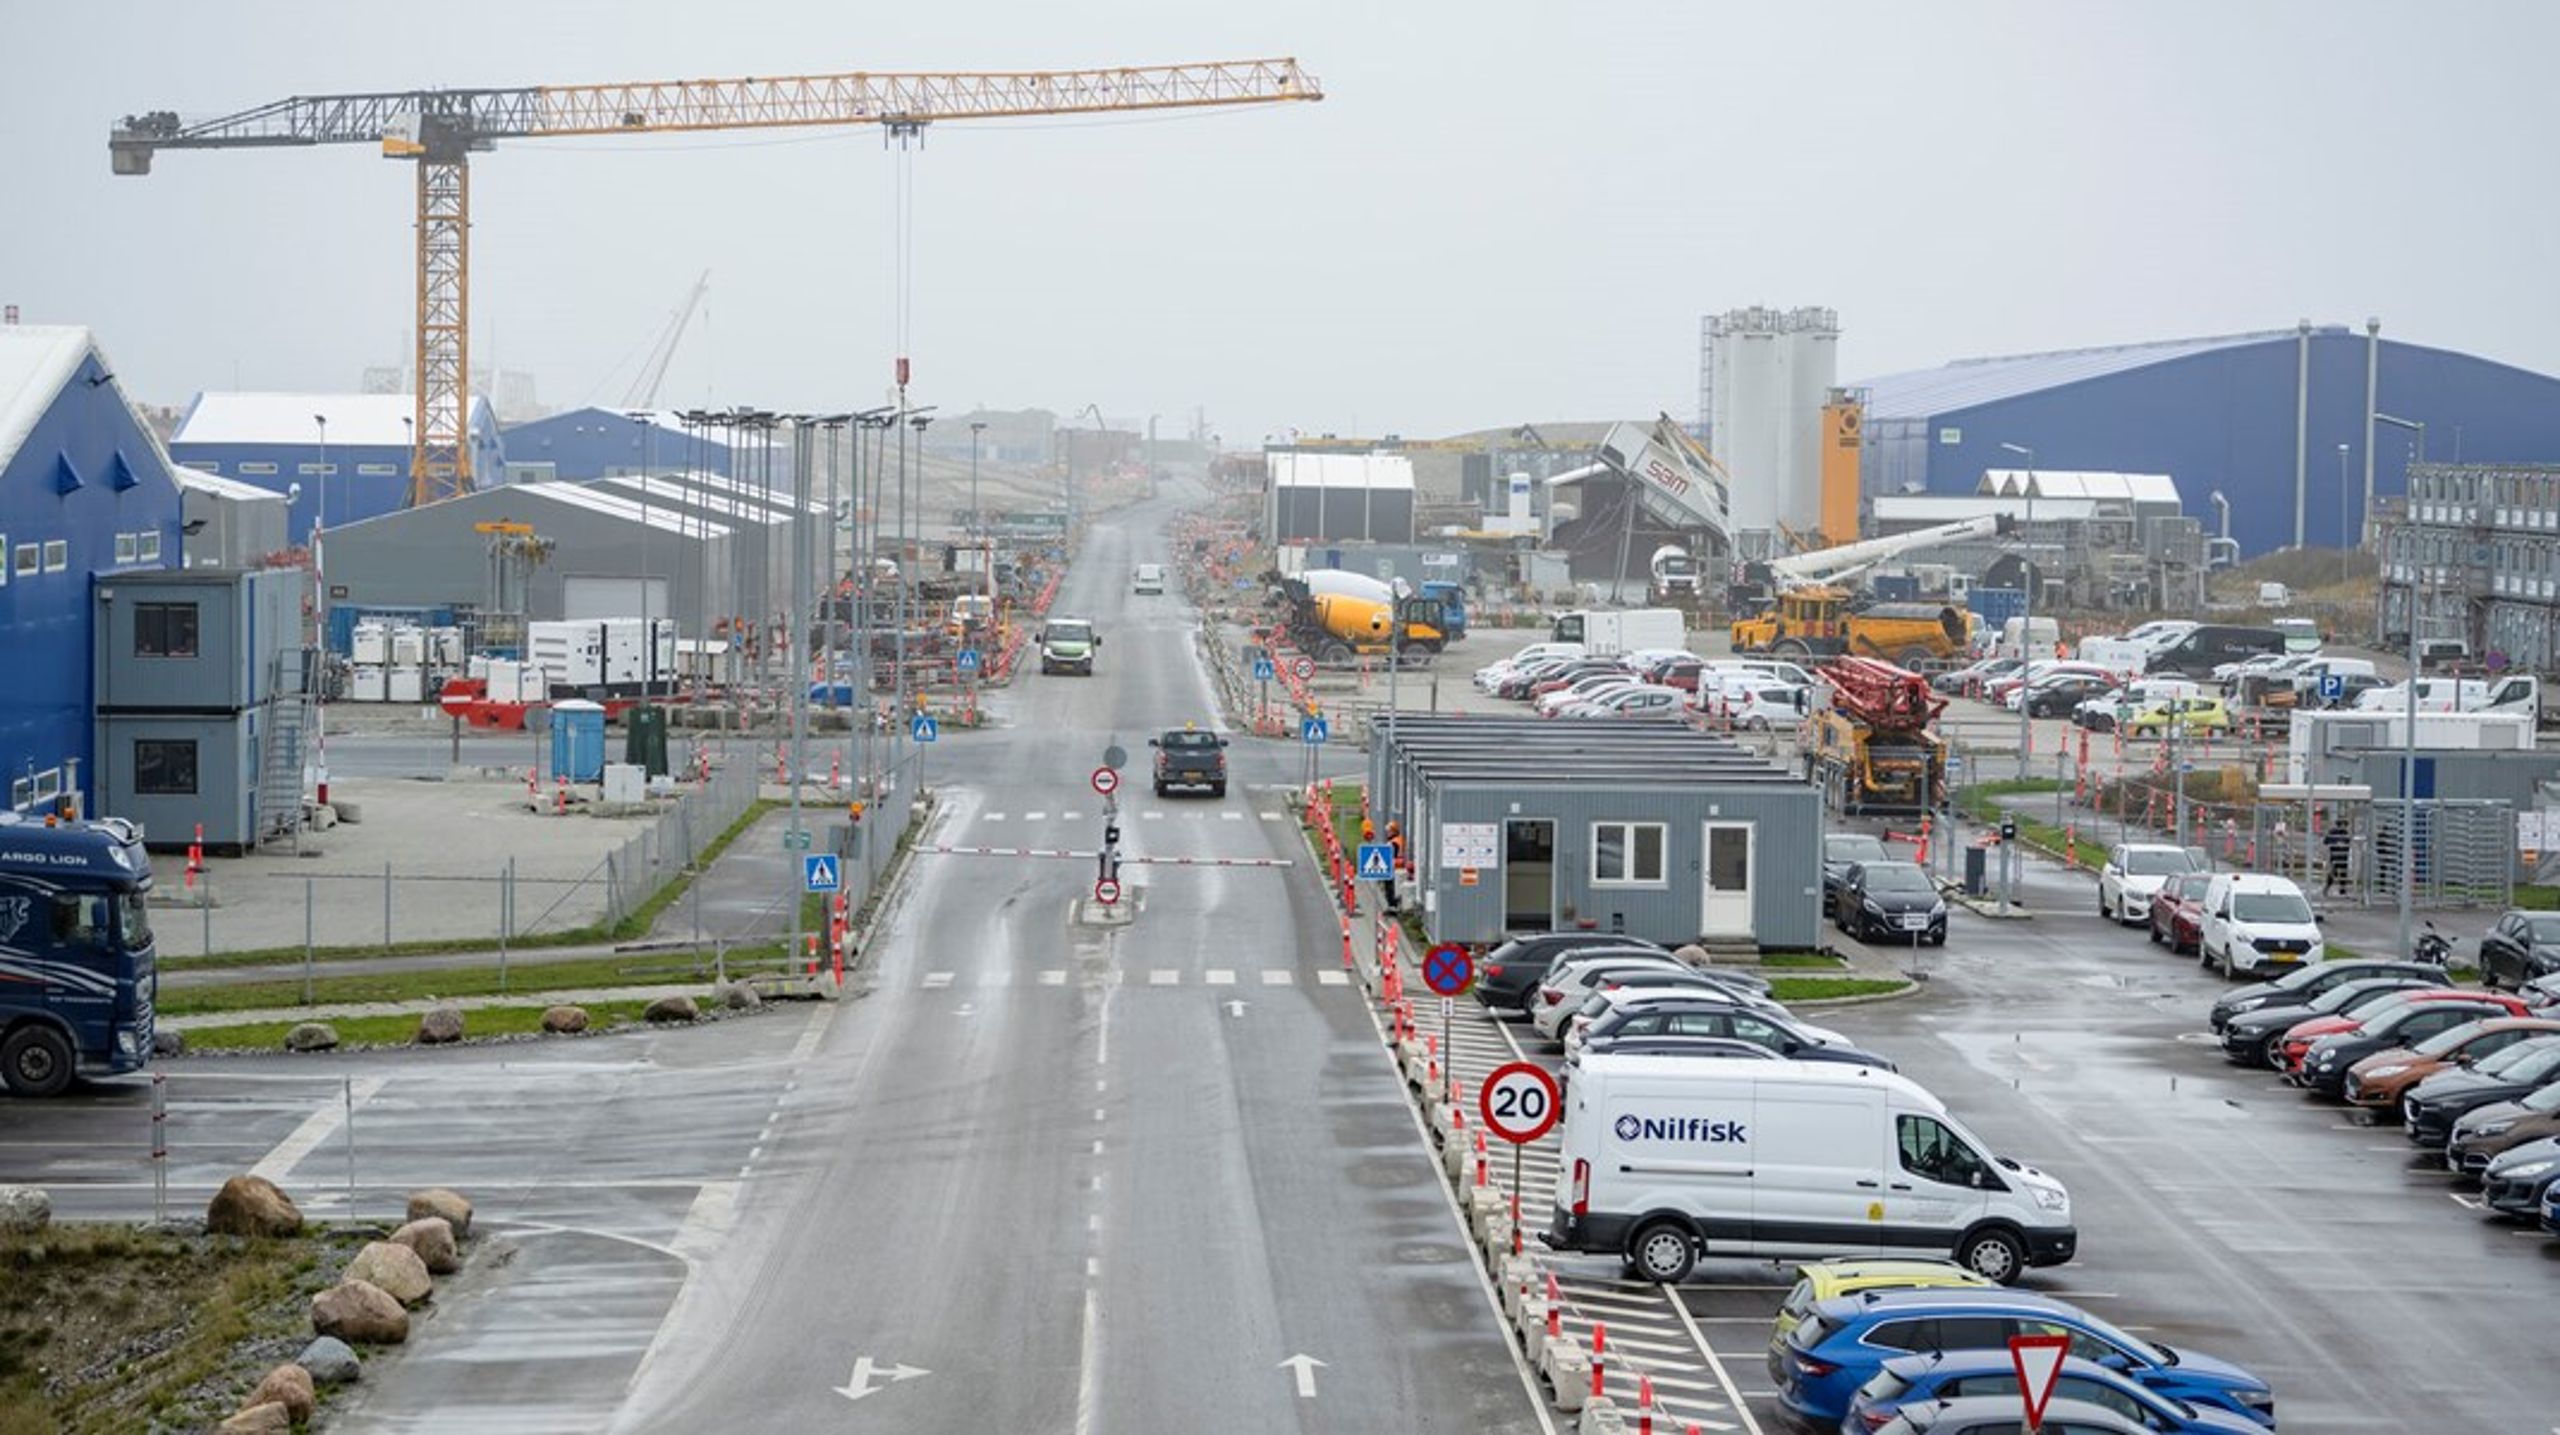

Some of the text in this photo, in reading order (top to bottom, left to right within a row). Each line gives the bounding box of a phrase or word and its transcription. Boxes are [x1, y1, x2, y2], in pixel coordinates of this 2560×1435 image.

[2325, 678, 2338, 695] P
[49, 853, 88, 866] LION
[1495, 1086, 1545, 1119] 20
[1644, 1117, 1747, 1143] Nilfisk
